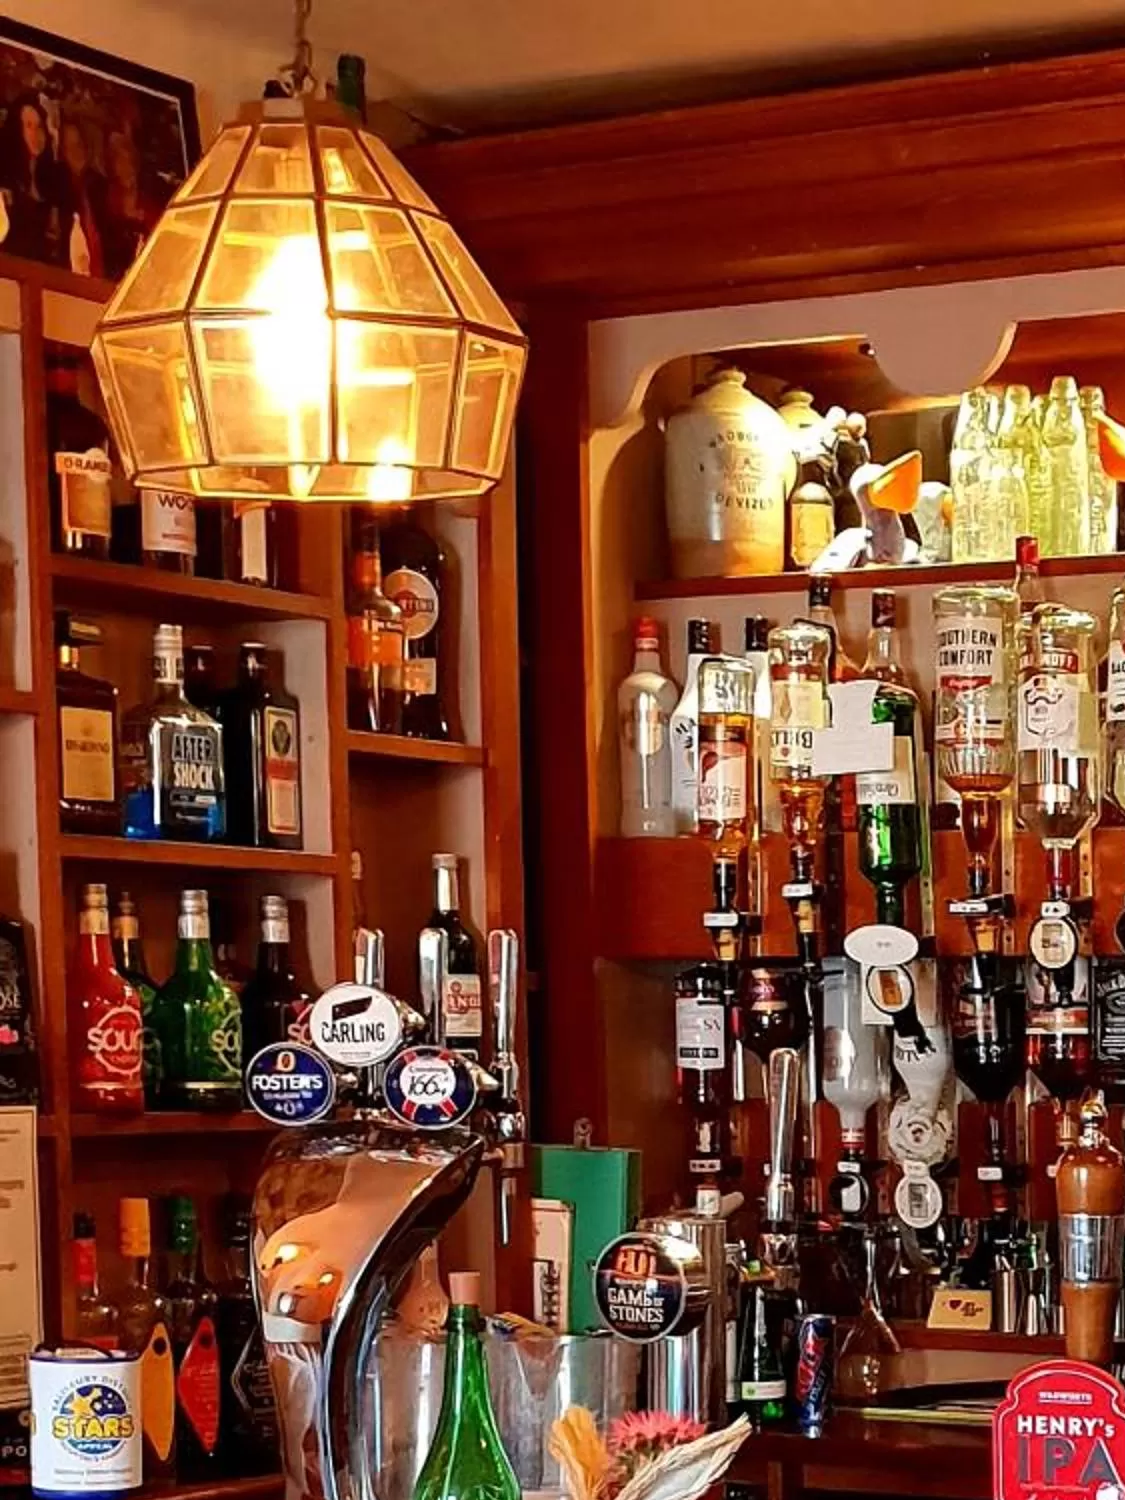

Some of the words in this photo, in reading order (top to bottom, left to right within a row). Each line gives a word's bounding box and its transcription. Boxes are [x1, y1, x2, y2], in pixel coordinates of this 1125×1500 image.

[171, 733, 219, 763] AFTER
[173, 762, 215, 790] SHOCK
[321, 1022, 386, 1044] CARLING
[608, 1305, 665, 1323] STONES
[53, 1415, 134, 1439] STARS
[1017, 1415, 1115, 1438] HENRY's
[1018, 1436, 1120, 1486] IPA
